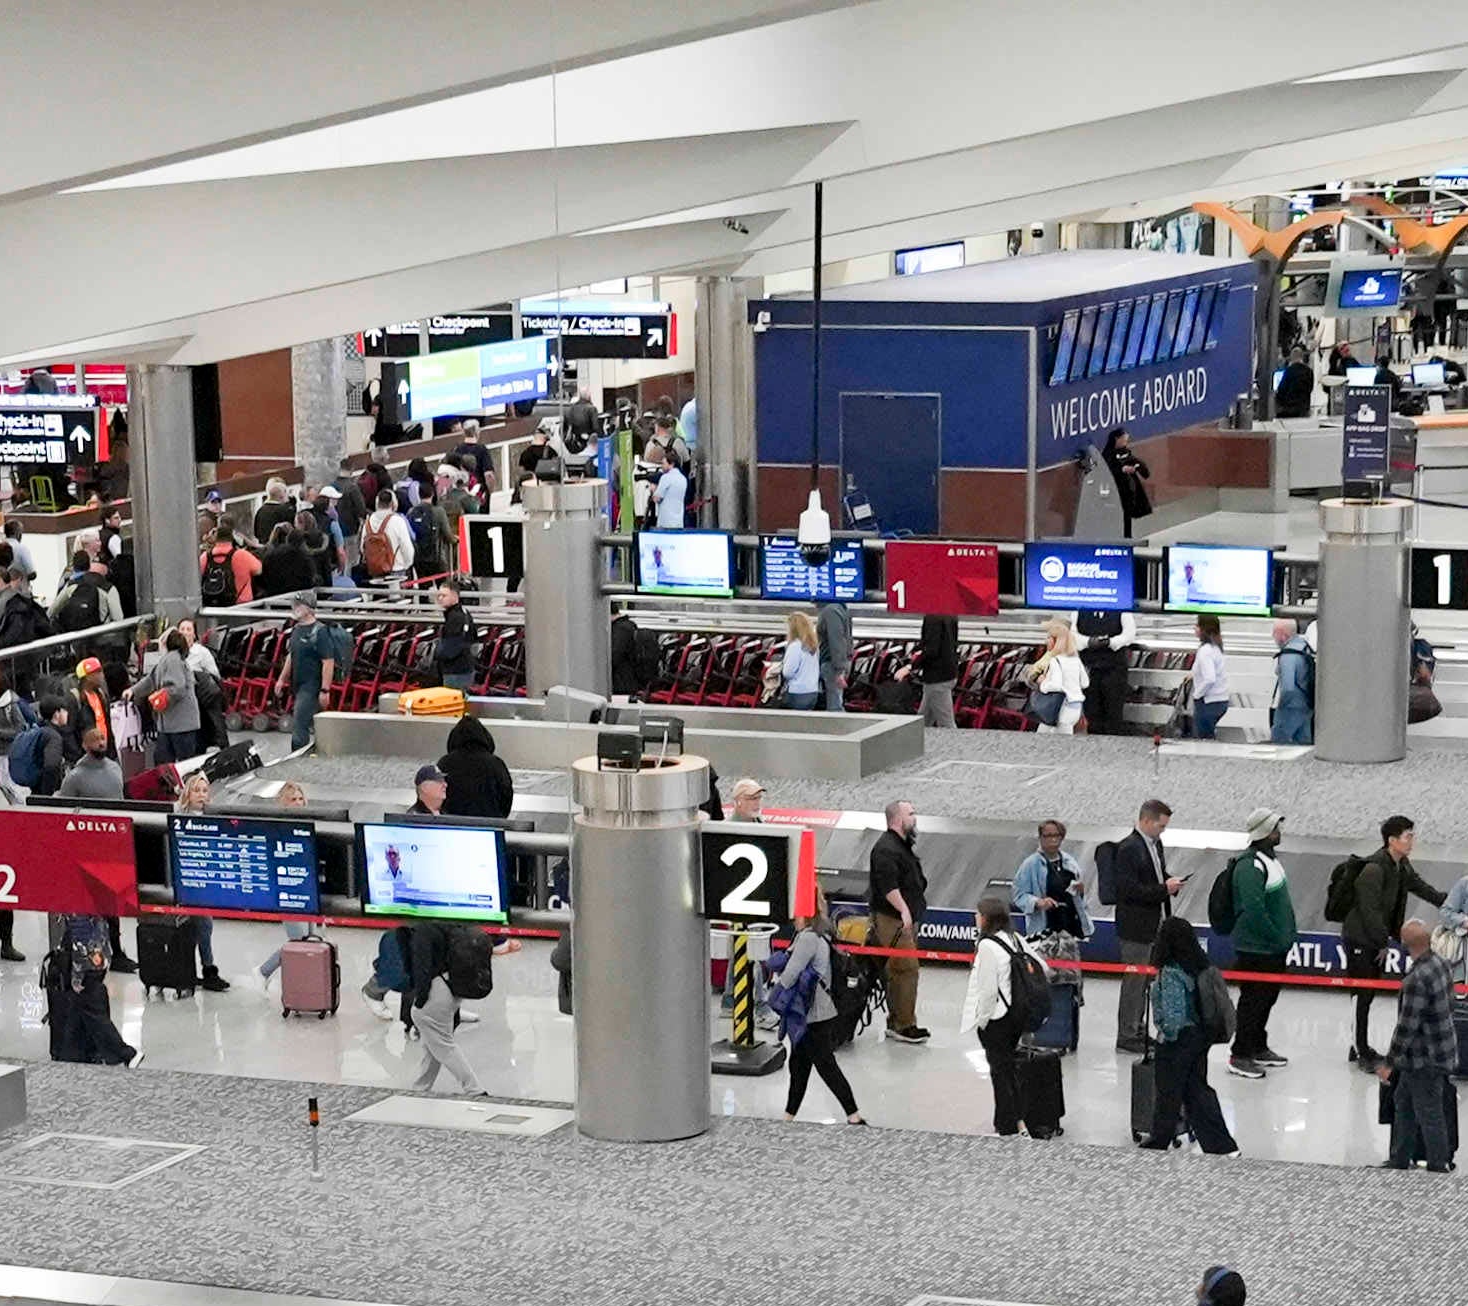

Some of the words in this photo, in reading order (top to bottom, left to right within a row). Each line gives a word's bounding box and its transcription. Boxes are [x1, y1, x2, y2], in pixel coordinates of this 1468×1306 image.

[433, 316, 490, 329] Checkpoint
[1051, 383, 1137, 440] WELCOME
[1141, 367, 1207, 418] ABOARD
[487, 528, 505, 572] 1
[956, 549, 986, 557] DELTA
[891, 580, 906, 608] 1
[1434, 555, 1452, 606] 1
[78, 821, 117, 832] DELTA
[719, 842, 770, 916] 2
[1286, 940, 1332, 972] ATL,
